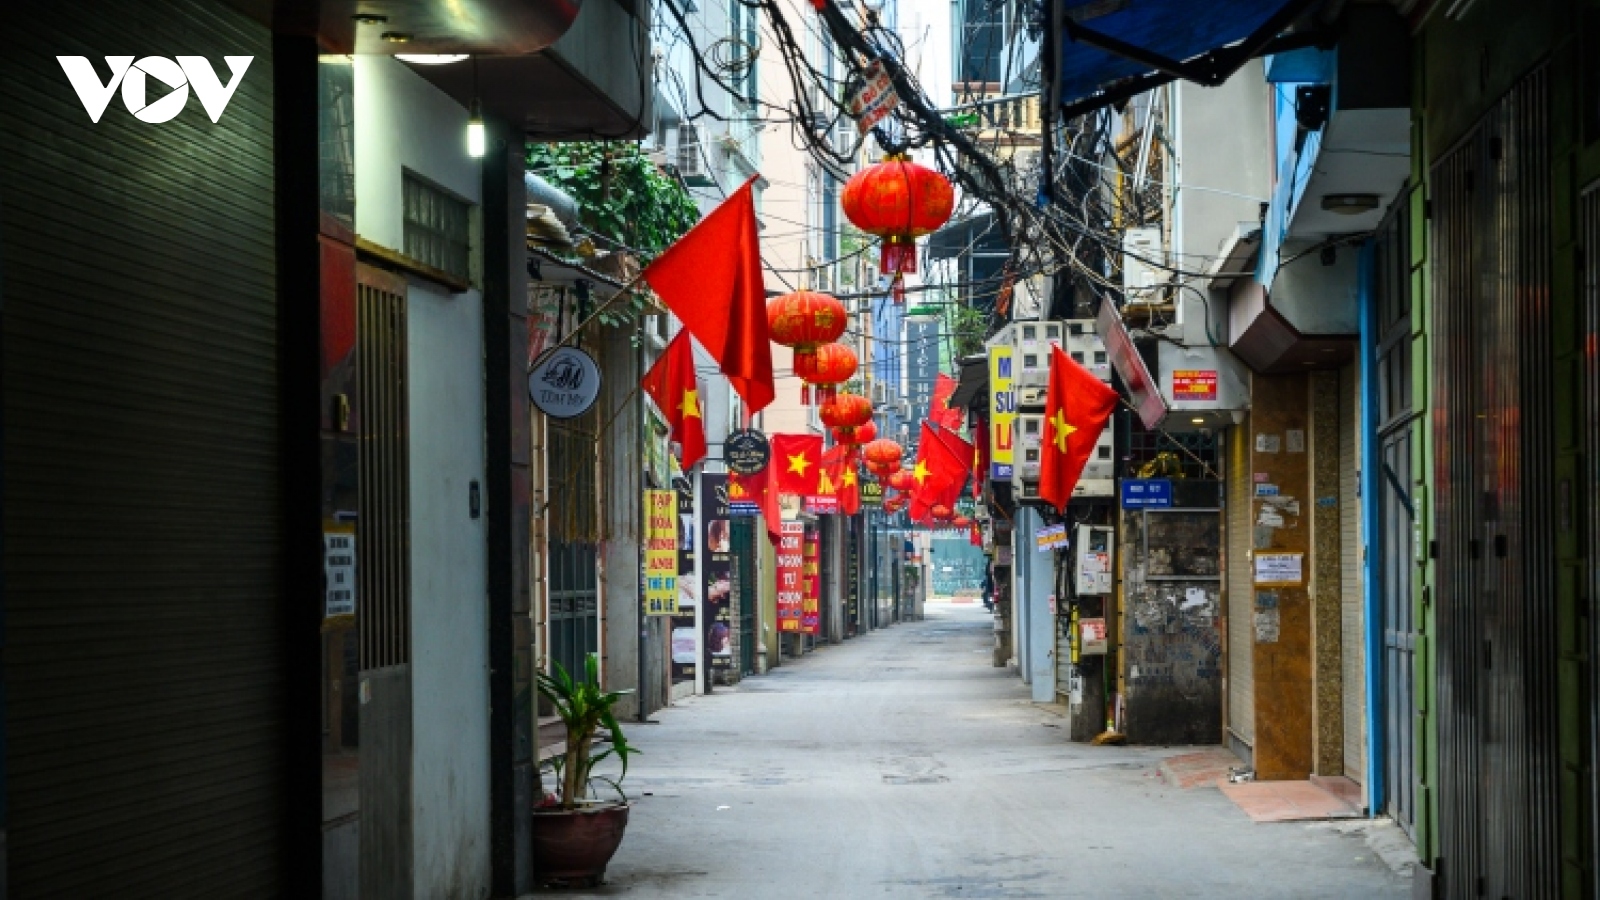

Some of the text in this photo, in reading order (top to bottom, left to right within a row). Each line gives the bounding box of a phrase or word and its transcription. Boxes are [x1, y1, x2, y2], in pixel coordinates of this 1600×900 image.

[650, 494, 673, 509] TẠP
[648, 539, 675, 550] MINH
[649, 558, 675, 569] ANH
